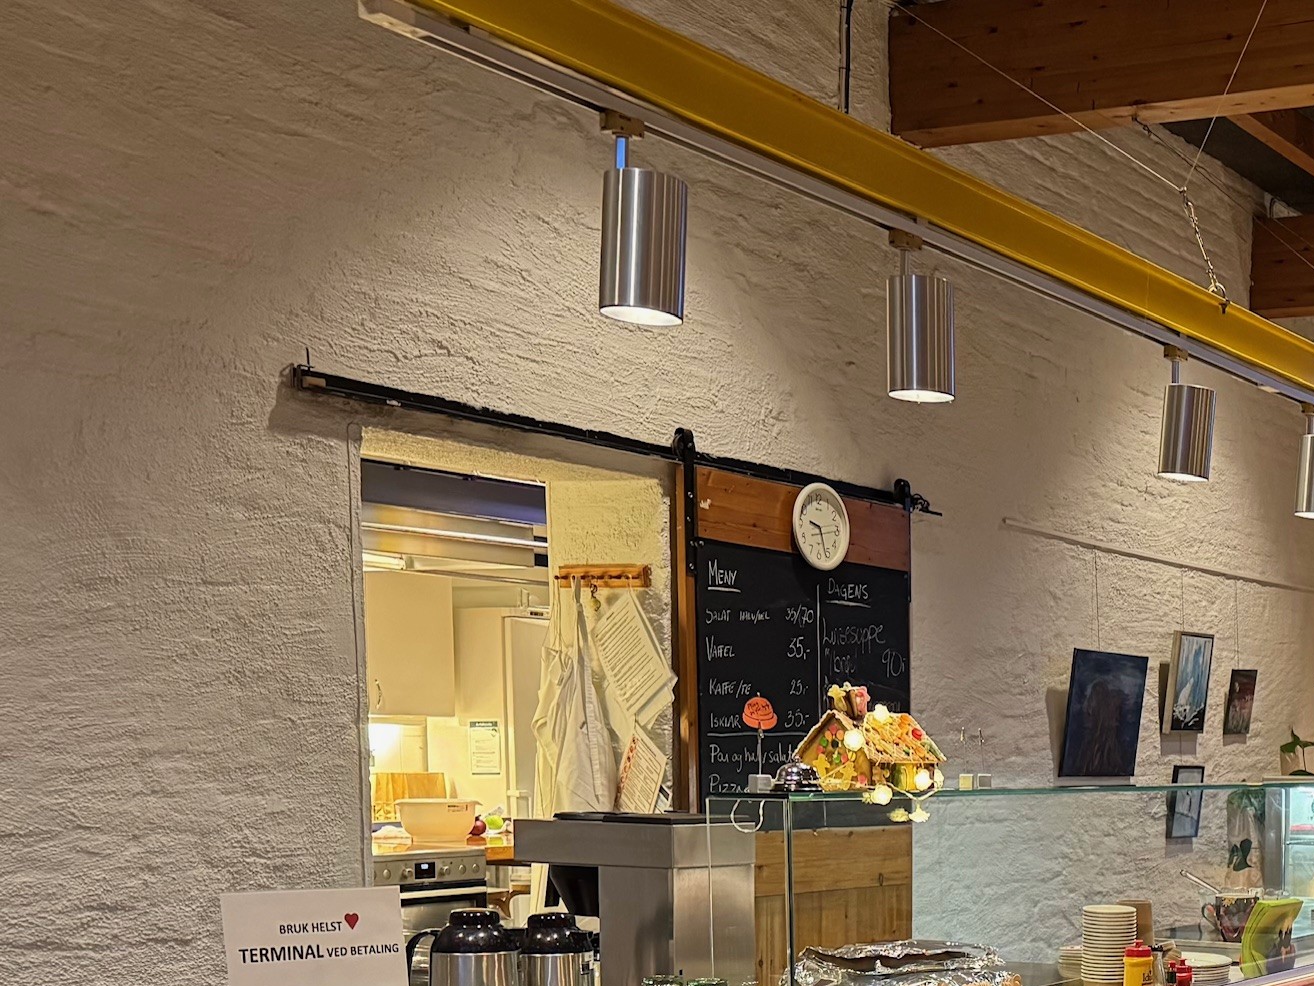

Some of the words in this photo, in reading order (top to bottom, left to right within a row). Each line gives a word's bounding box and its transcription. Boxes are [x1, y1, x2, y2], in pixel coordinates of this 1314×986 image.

[827, 577, 869, 600] DAGENS
[279, 923, 309, 935] BRUK
[311, 921, 343, 933] HELST
[238, 944, 324, 964] TERMINAL
[326, 946, 348, 958] VED
[350, 943, 399, 956] BETALING
